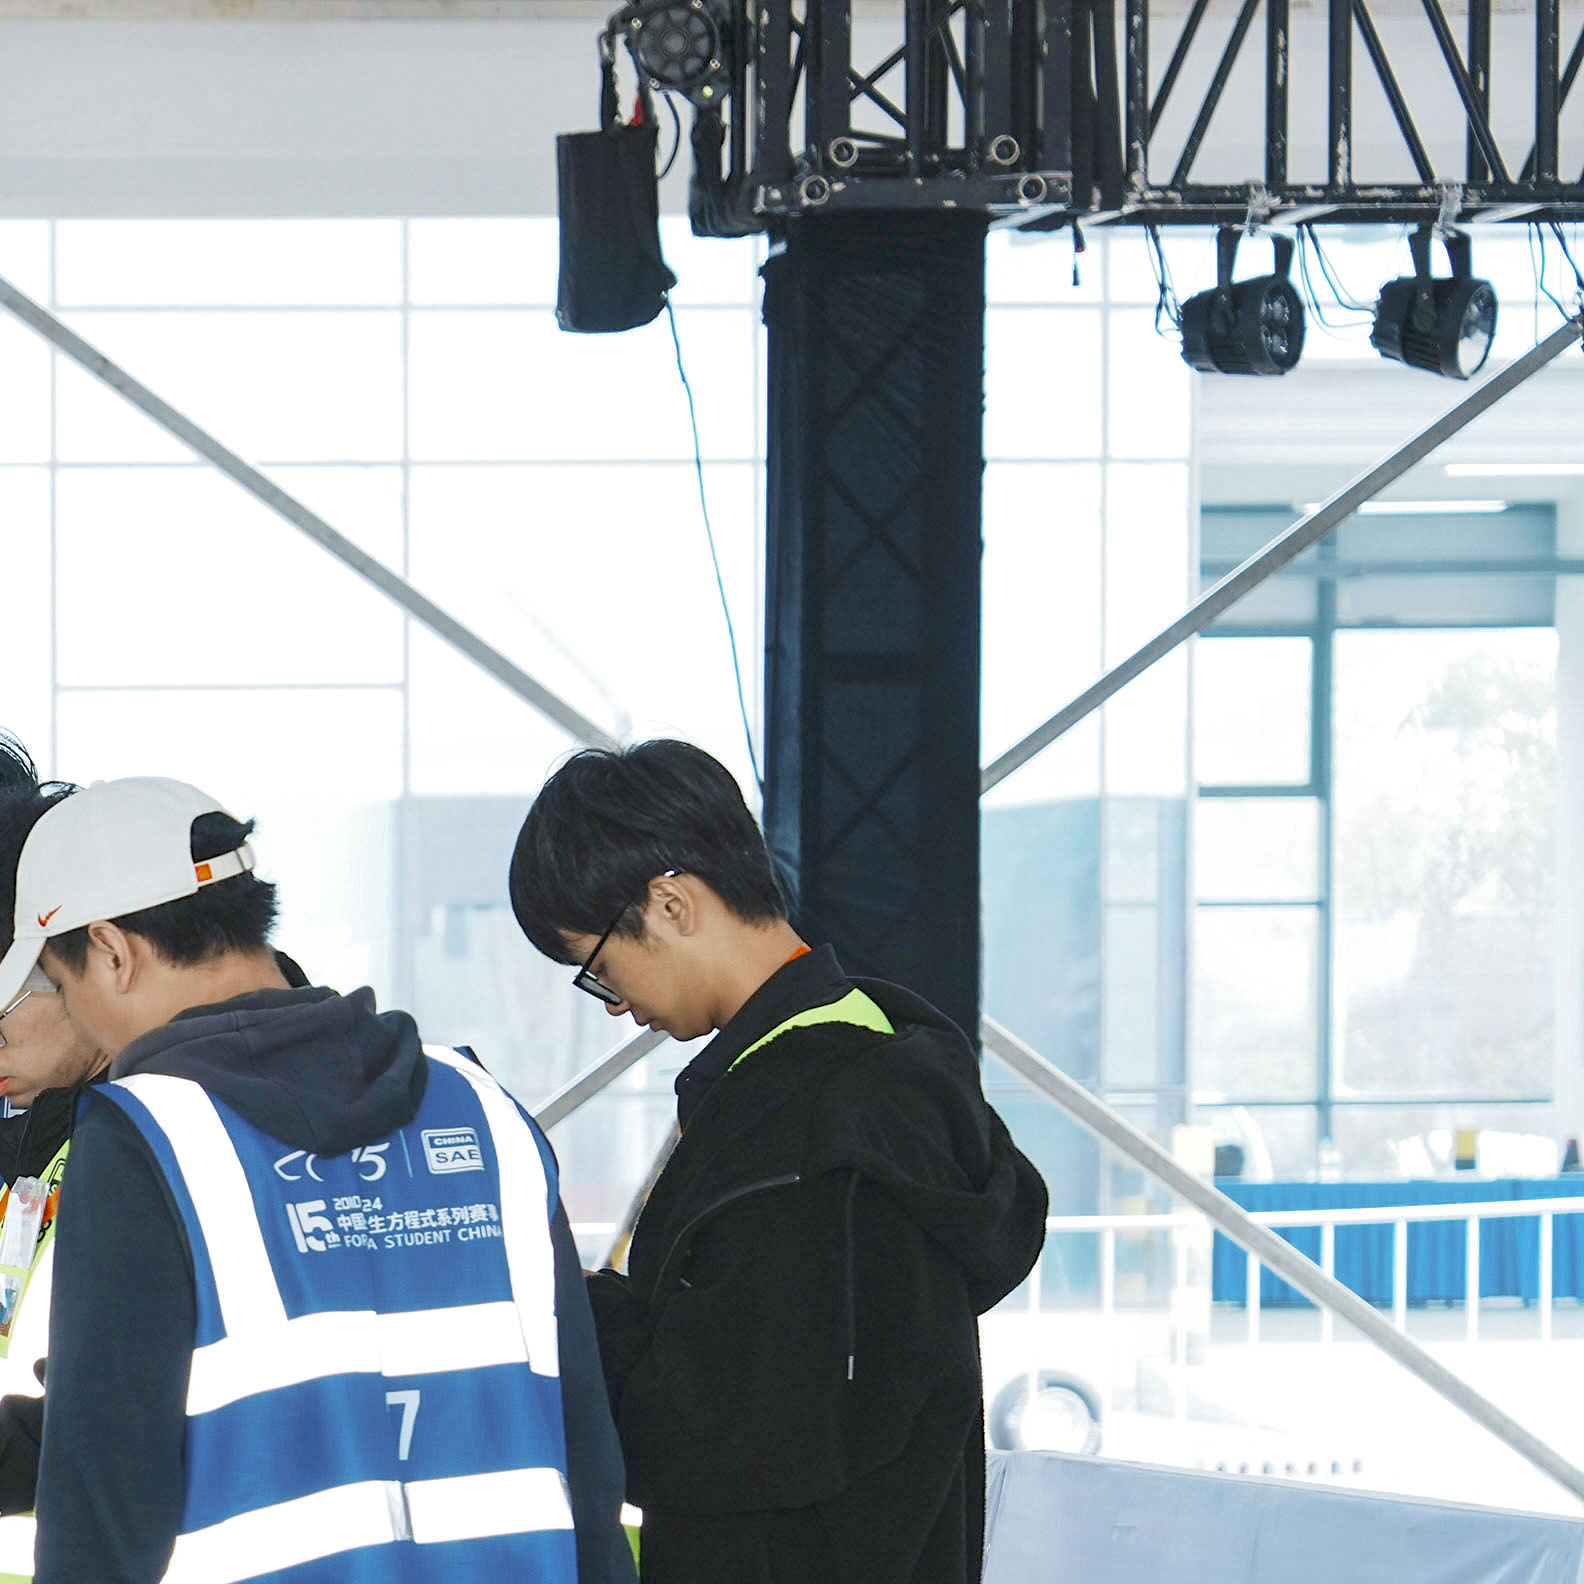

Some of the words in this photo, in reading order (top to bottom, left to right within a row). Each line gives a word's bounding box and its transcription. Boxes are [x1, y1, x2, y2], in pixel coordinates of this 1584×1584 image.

[433, 1135, 474, 1146] CHINA
[435, 1149, 480, 1164] SAE
[384, 1229, 452, 1249] STUDENT
[385, 1389, 420, 1461] 7
